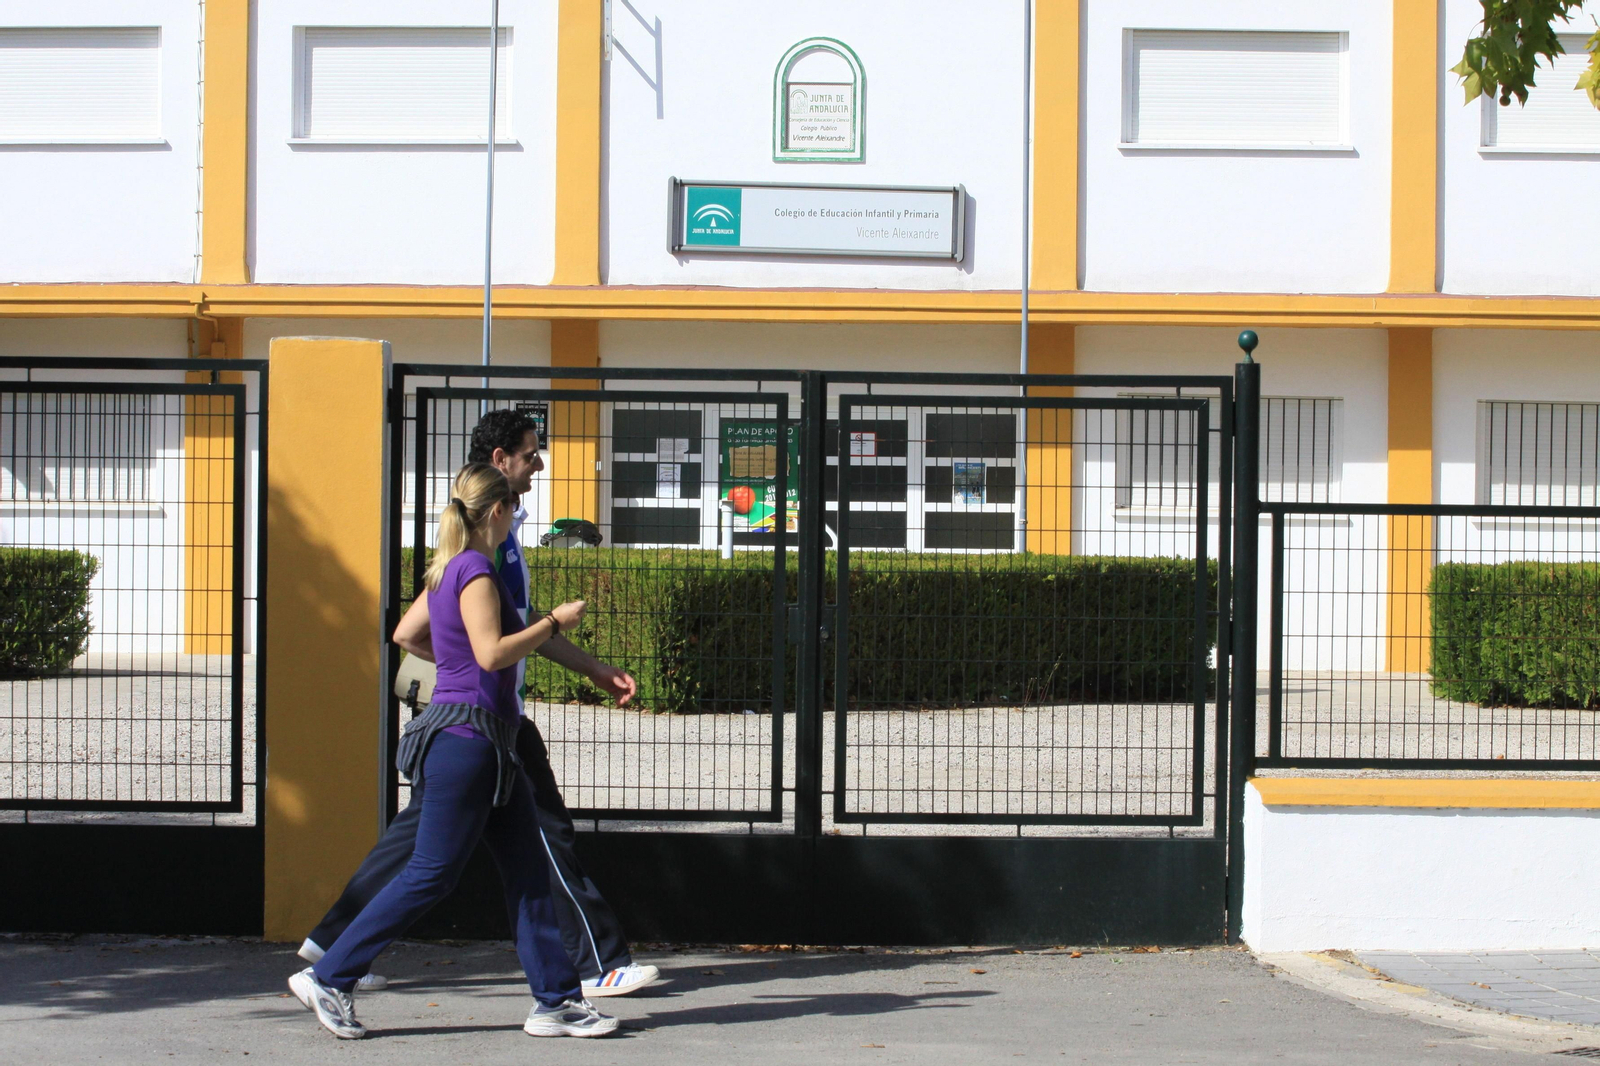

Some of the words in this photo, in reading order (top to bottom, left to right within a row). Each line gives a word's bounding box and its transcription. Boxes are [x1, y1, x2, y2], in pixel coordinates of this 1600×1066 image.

[774, 208, 806, 219] Colegio
[808, 208, 818, 218] de
[820, 208, 862, 218] Educación
[865, 209, 894, 218] Infantil
[896, 212, 902, 220] y
[904, 210, 940, 219] Primaria
[856, 226, 889, 239] Vicente
[892, 228, 940, 240] Aleixandre
[750, 428, 762, 436] DE
